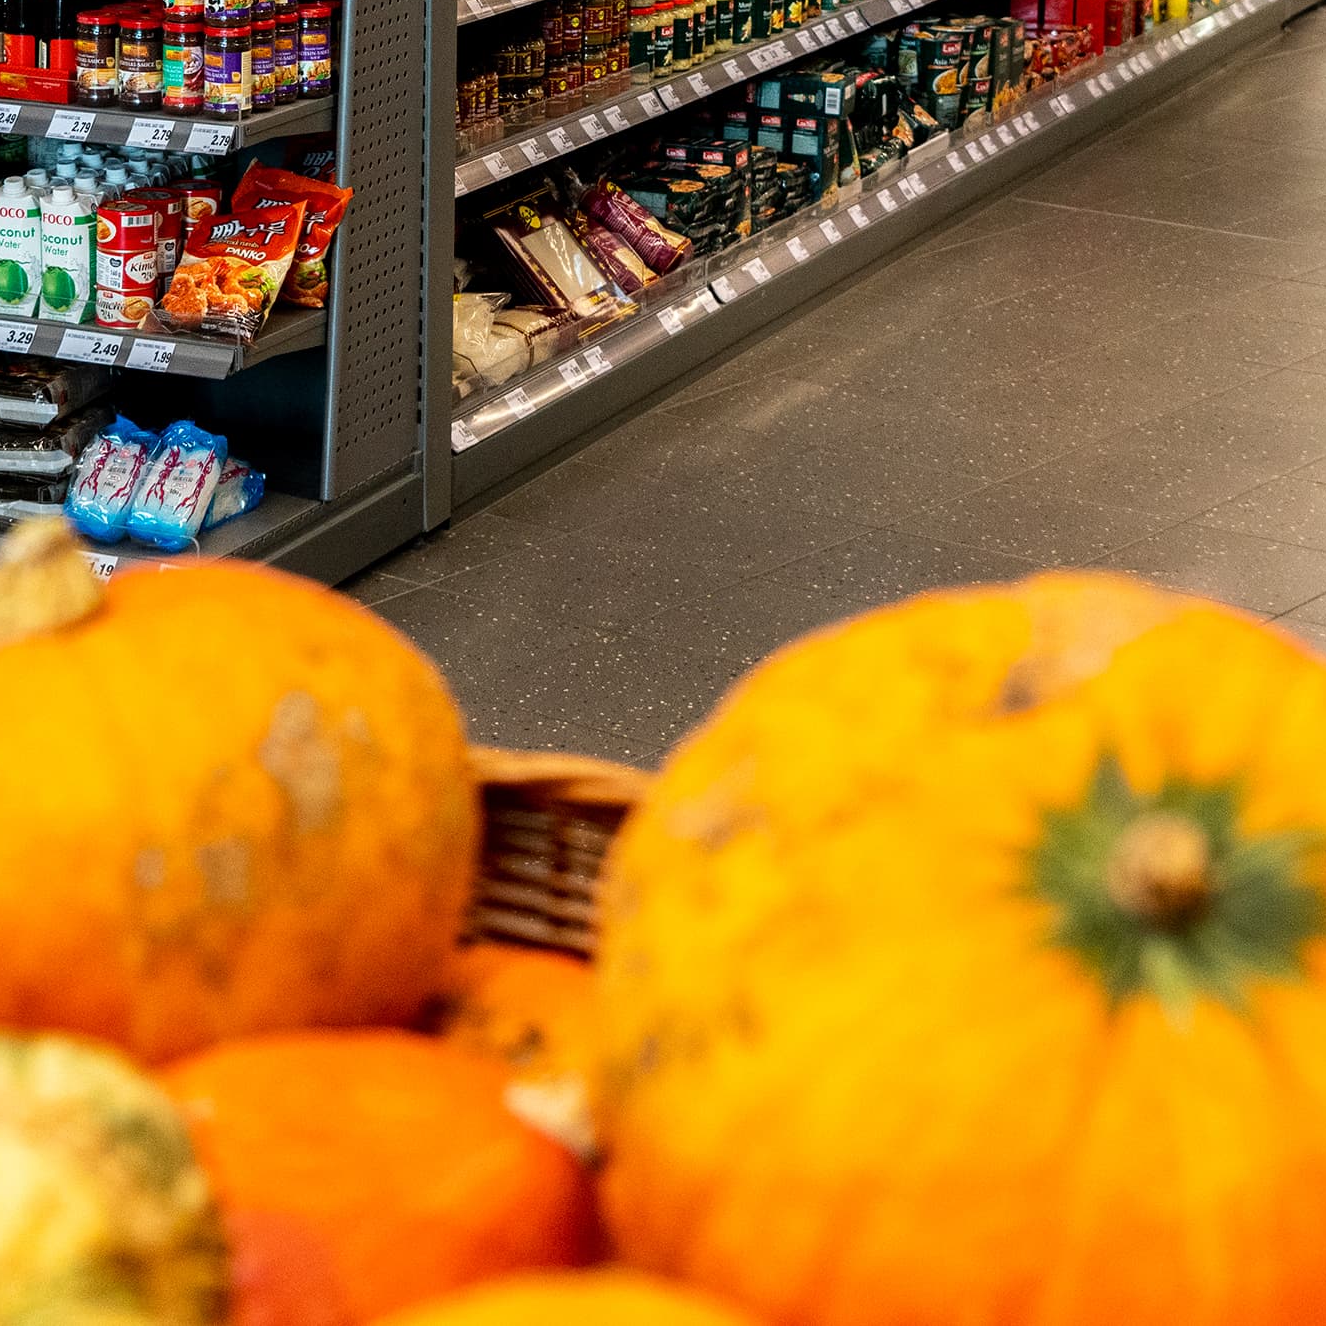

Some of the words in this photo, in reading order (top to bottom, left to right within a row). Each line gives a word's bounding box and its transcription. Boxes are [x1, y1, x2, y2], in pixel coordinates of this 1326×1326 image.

[72, 121, 91, 133] 2.79
[153, 129, 171, 141] 2.79
[212, 134, 230, 147] 2.79
[42, 213, 73, 226] FOCO
[44, 246, 68, 257] Water
[226, 246, 267, 262] PANKO
[6, 330, 33, 344] 3.29
[92, 342, 119, 356] 2.49
[154, 350, 172, 363] 1.99
